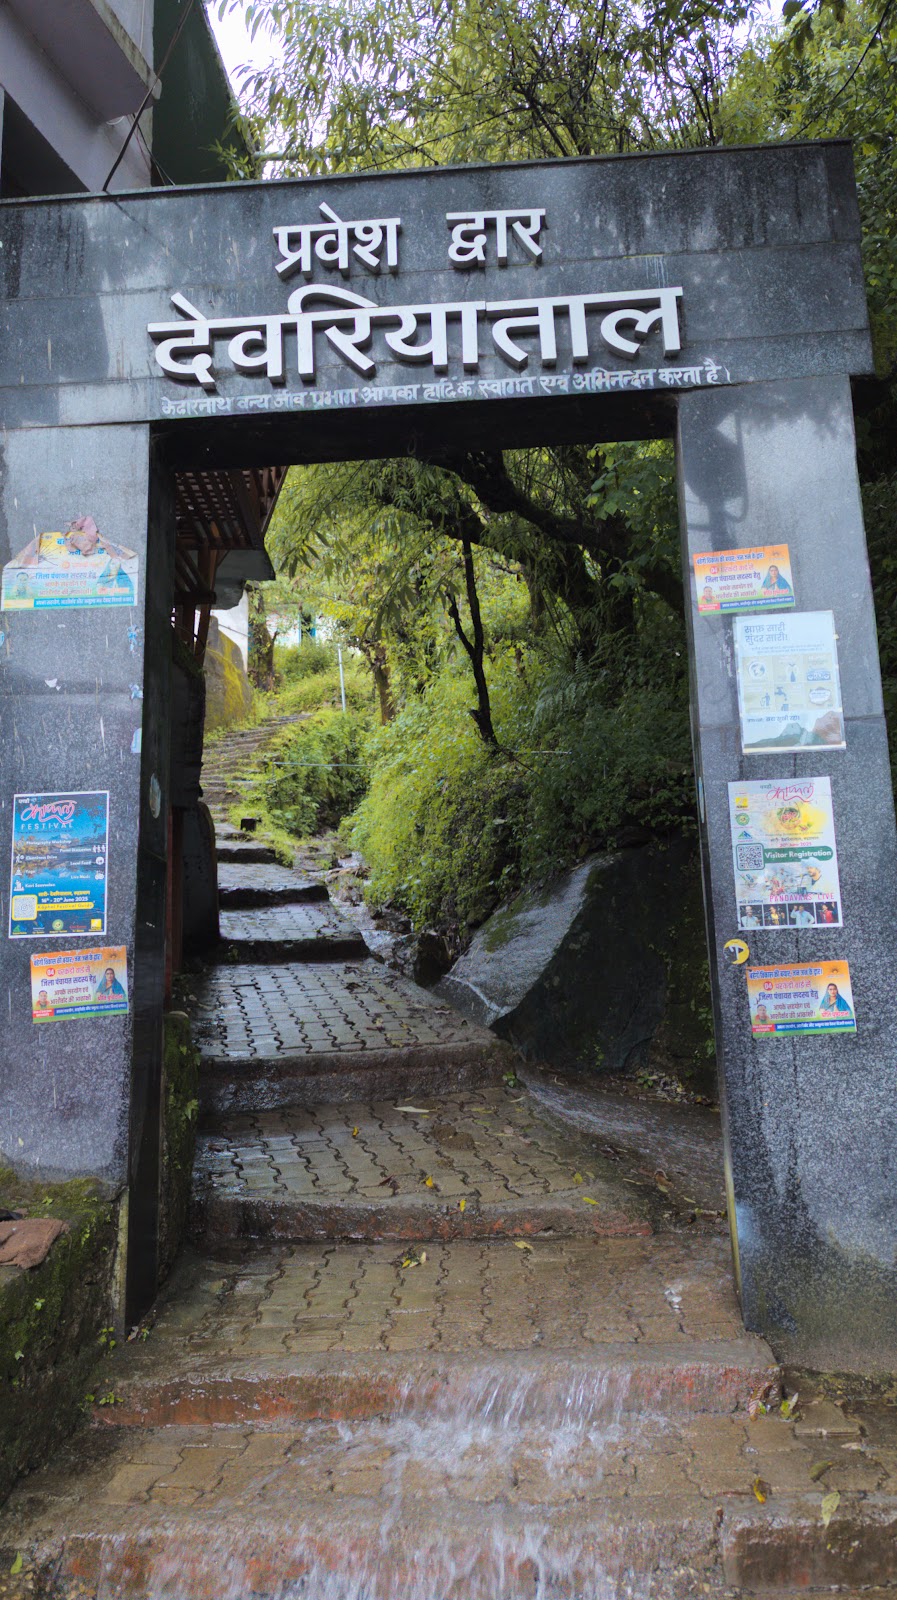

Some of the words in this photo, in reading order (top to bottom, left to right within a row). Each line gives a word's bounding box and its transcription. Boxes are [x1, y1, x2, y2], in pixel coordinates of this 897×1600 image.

[272, 201, 400, 276] प्रवेश
[446, 208, 546, 264] द्वार
[147, 284, 683, 384] देवरियाताल
[161, 396, 232, 415] केदारनाथ
[237, 394, 271, 409] वन्य
[274, 389, 307, 408] जीव
[310, 388, 358, 408] प्रभाग
[361, 385, 421, 403] आपका
[478, 376, 537, 398] स्वागत
[658, 366, 704, 386] करता
[767, 622, 785, 631] सारी
[745, 634, 764, 645] सुंदर
[789, 850, 832, 858] Registration
[41, 978, 54, 986] जिला
[759, 992, 773, 1001] जिला
